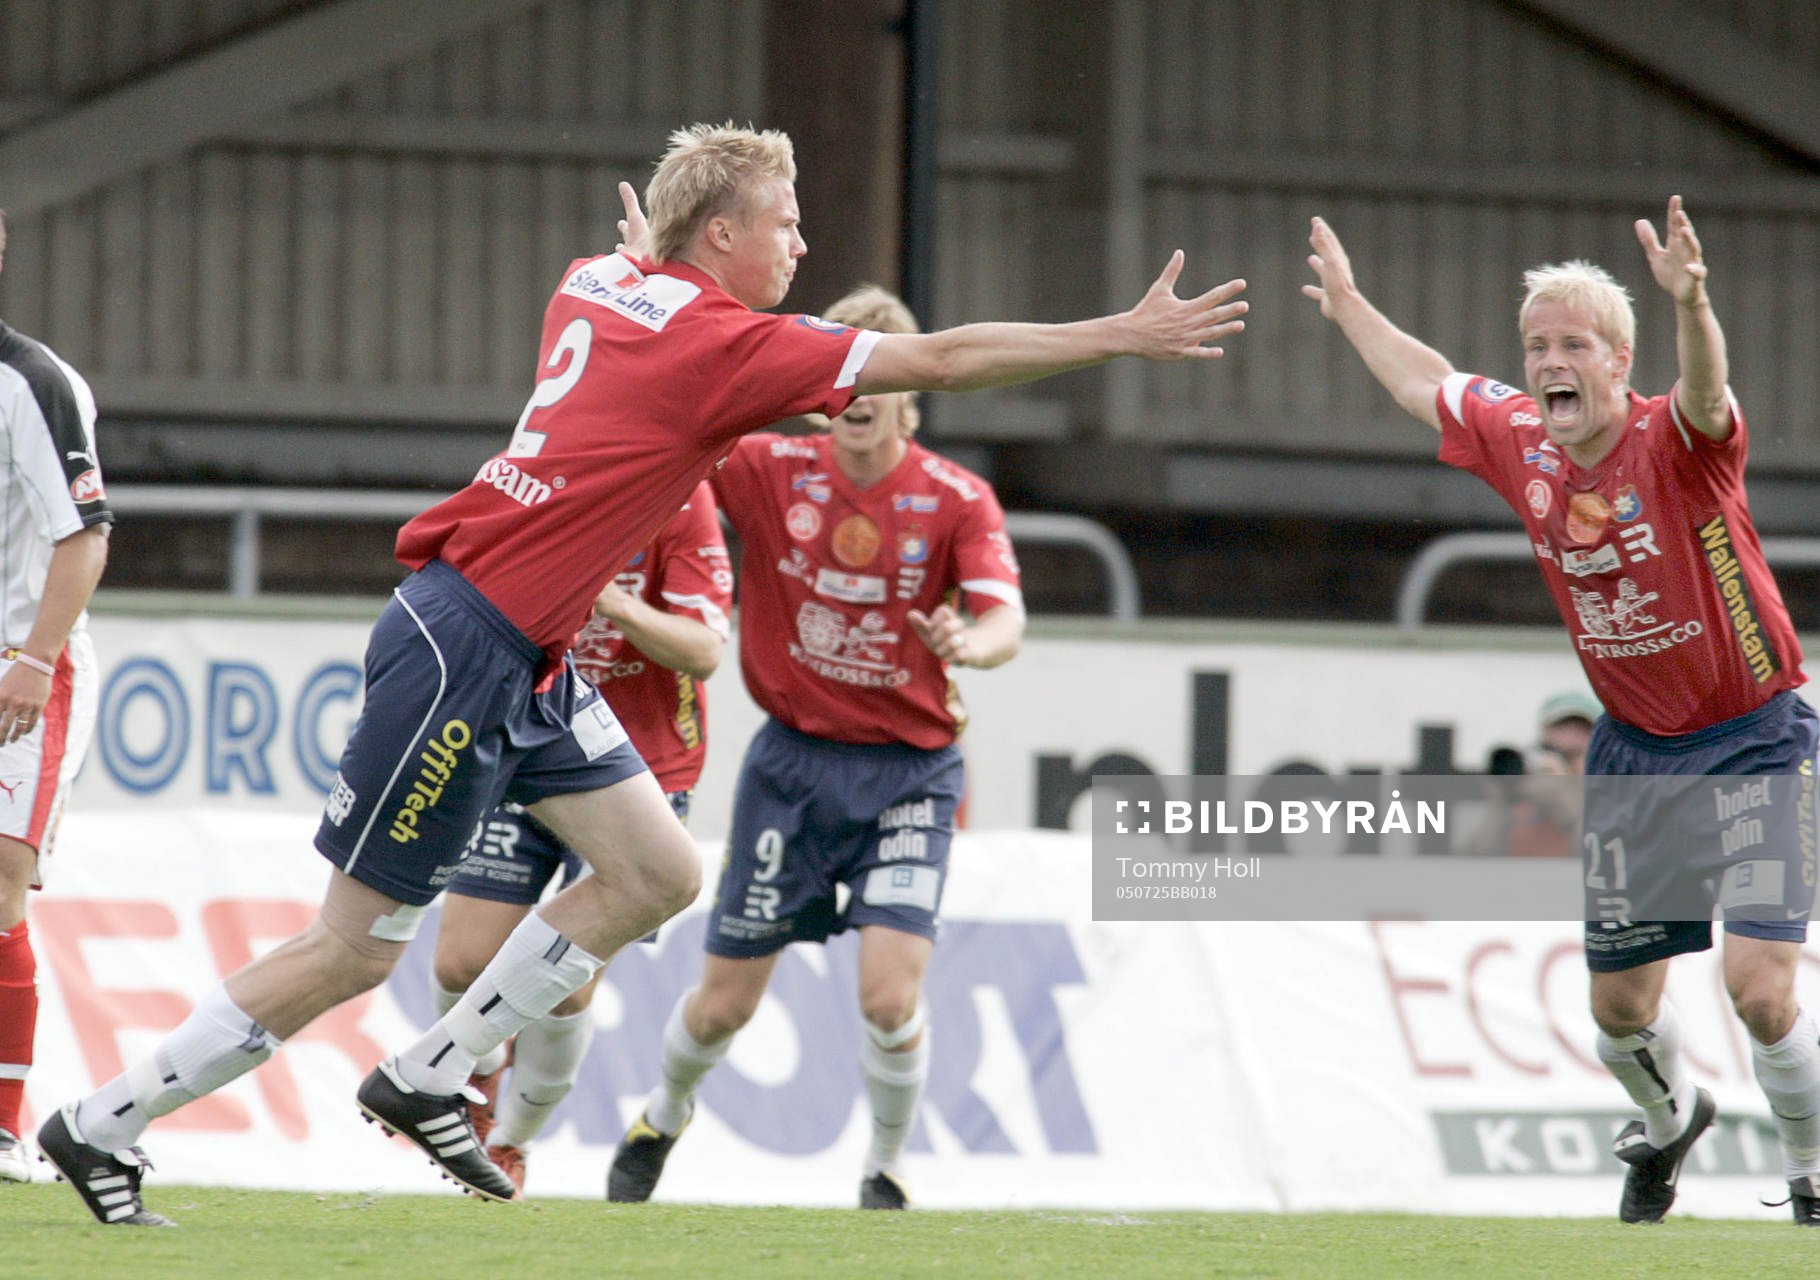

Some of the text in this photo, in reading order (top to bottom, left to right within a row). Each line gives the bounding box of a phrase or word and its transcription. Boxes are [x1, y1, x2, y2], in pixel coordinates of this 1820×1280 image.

[507, 317, 593, 459] 2
[1699, 516, 1776, 684] Wallenstam
[388, 719, 472, 843] OffiTech
[1713, 776, 1772, 821] hotel
[753, 827, 783, 883] 9
[1583, 831, 1627, 890] 21
